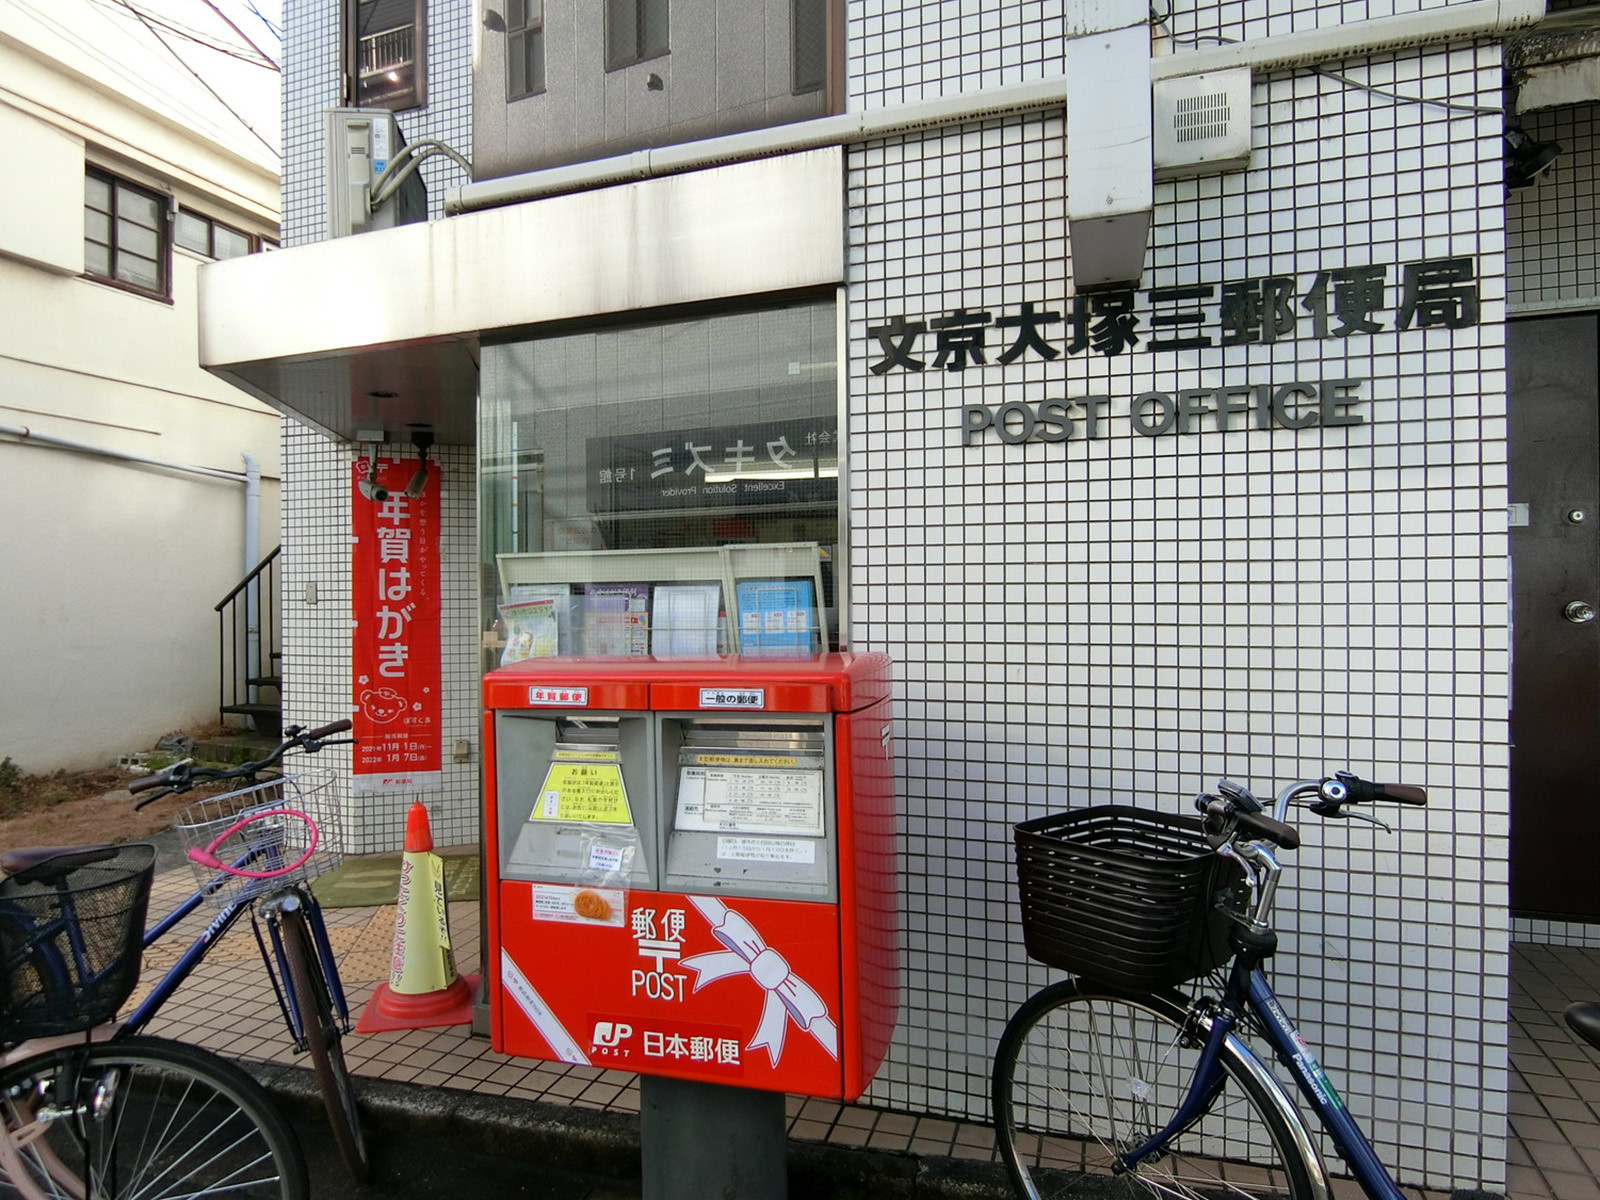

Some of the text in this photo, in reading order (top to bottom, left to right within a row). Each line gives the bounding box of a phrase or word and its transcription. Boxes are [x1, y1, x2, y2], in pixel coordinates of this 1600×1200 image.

[867, 256, 1482, 376] 文京大塚三郵便局
[961, 377, 1365, 447] POST OFFICE
[376, 490, 416, 678] 年賀はがき
[535, 691, 582, 702] 年賀郵便
[705, 693, 759, 704] 一般の郵便
[631, 907, 686, 943] 郵便
[631, 970, 688, 1002] POST
[591, 1046, 630, 1057] POST
[643, 1031, 741, 1065] 日本郵便
[1292, 1053, 1328, 1105] Panasonic
